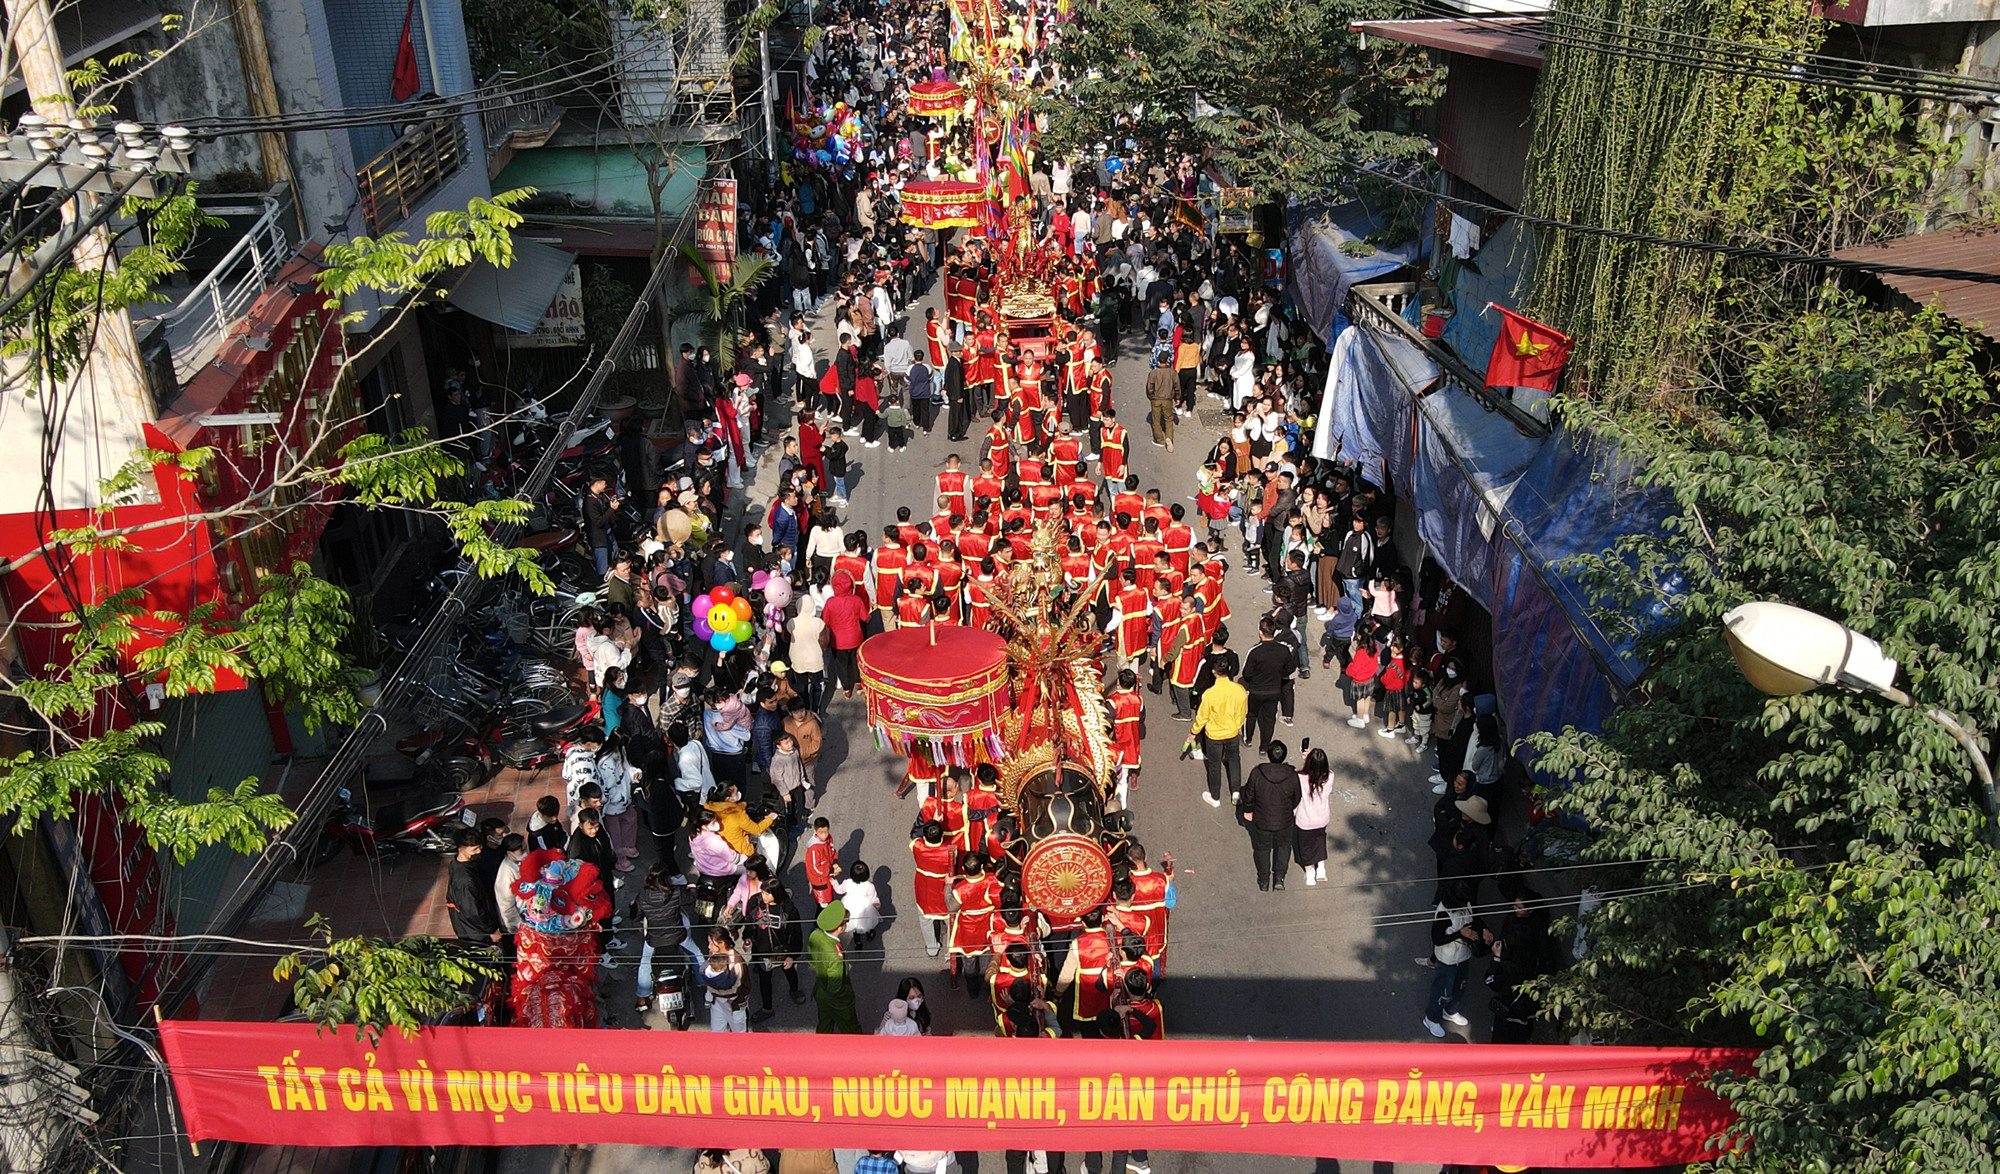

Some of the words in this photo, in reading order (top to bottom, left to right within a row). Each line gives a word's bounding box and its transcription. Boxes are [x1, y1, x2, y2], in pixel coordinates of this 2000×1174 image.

[257, 1050, 326, 1111] TẤT
[337, 1052, 394, 1112] CẢ
[399, 1060, 439, 1112] VÌ
[446, 1070, 533, 1122] MỤC
[543, 1063, 624, 1114] TIÊU
[635, 1065, 713, 1115] DÂN
[723, 1067, 821, 1123] GIÀU,
[832, 1070, 933, 1119] NƯỚC
[946, 1078, 1067, 1129] MẠNH,
[1078, 1073, 1155, 1121] DÂN
[1166, 1069, 1249, 1128] CHỦ,
[1263, 1073, 1365, 1124] CÔNG
[1373, 1067, 1484, 1133] BẰNG,
[1499, 1073, 1576, 1128] VĂN
[1581, 1085, 1685, 1130] MINH
